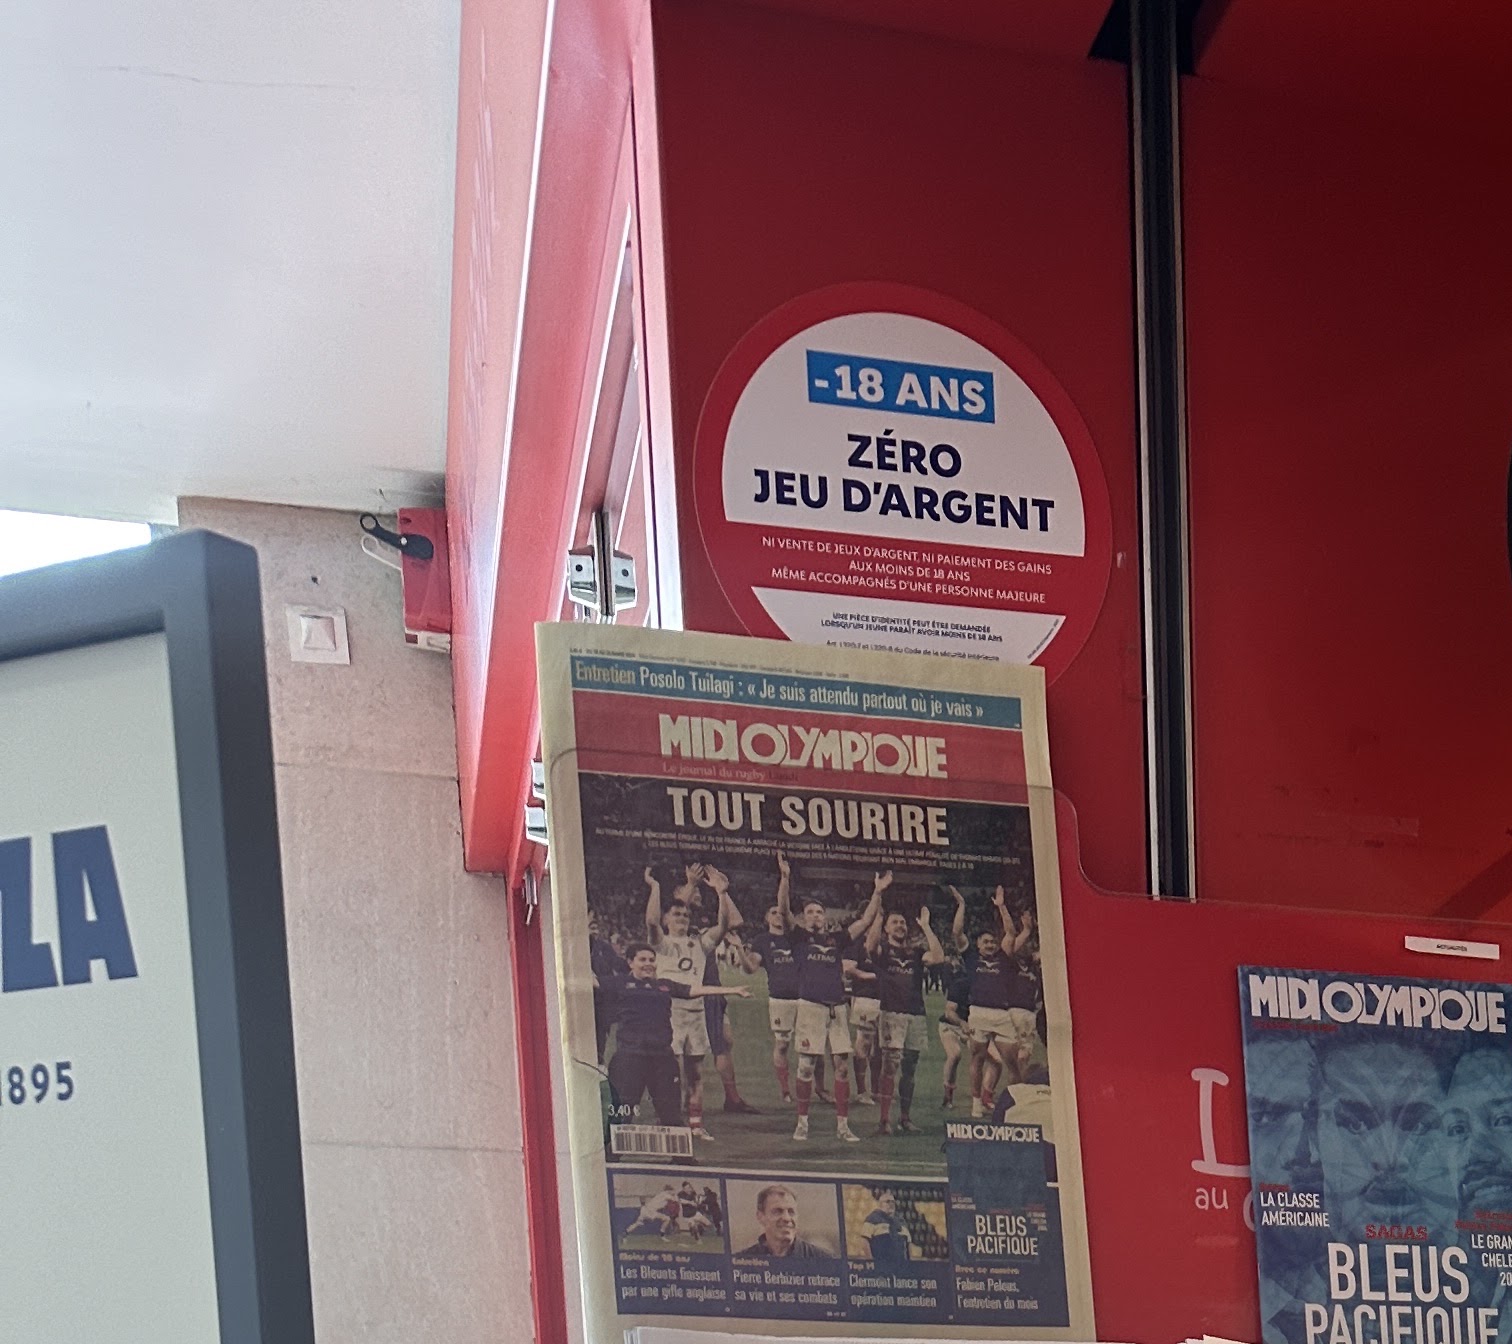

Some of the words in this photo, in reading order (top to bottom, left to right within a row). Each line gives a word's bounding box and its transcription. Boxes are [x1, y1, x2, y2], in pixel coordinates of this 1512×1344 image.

[814, 365, 884, 404] -18
[896, 373, 986, 415] ANS
[847, 429, 962, 477] ZÉRO
[753, 468, 828, 510] JEU
[843, 478, 1055, 533] D'ARGENT
[762, 537, 774, 547] NI
[777, 539, 814, 551] VENTE
[817, 542, 831, 552] DE
[834, 544, 860, 556] JEUX
[922, 552, 935, 563] NI
[938, 553, 991, 569] PAIEMENT
[995, 559, 1015, 570] DES
[1018, 561, 1052, 574] GAINS
[771, 567, 805, 580] MÊME
[809, 571, 896, 589] ACCOMPAGNÉS
[899, 580, 932, 593] D'UNE
[936, 584, 993, 599] PERSONNE
[996, 590, 1045, 603] MAJEURE
[576, 661, 636, 686] Entretien
[640, 666, 684, 690] Posolo
[690, 671, 735, 694] Tuilagi
[759, 679, 775, 700] Je
[779, 681, 806, 702] suis
[810, 685, 858, 707] attendu
[863, 688, 908, 713] partout
[911, 692, 926, 712] où
[929, 695, 943, 717] je
[946, 697, 972, 717] vais
[658, 714, 738, 765] MIDI
[741, 723, 948, 779] OLYMPIQUE
[667, 786, 765, 832] TOUT
[782, 795, 950, 846] SOURIRE
[1249, 974, 1320, 1020] MIDI
[1323, 982, 1507, 1033] OLYMPIQUE
[1260, 1192, 1274, 1207] LA
[1277, 1192, 1321, 1209] CLASSE
[1261, 1208, 1330, 1227] AMÉRICAINE
[1471, 1234, 1484, 1249] LE
[1327, 1243, 1468, 1302] BLEUS
